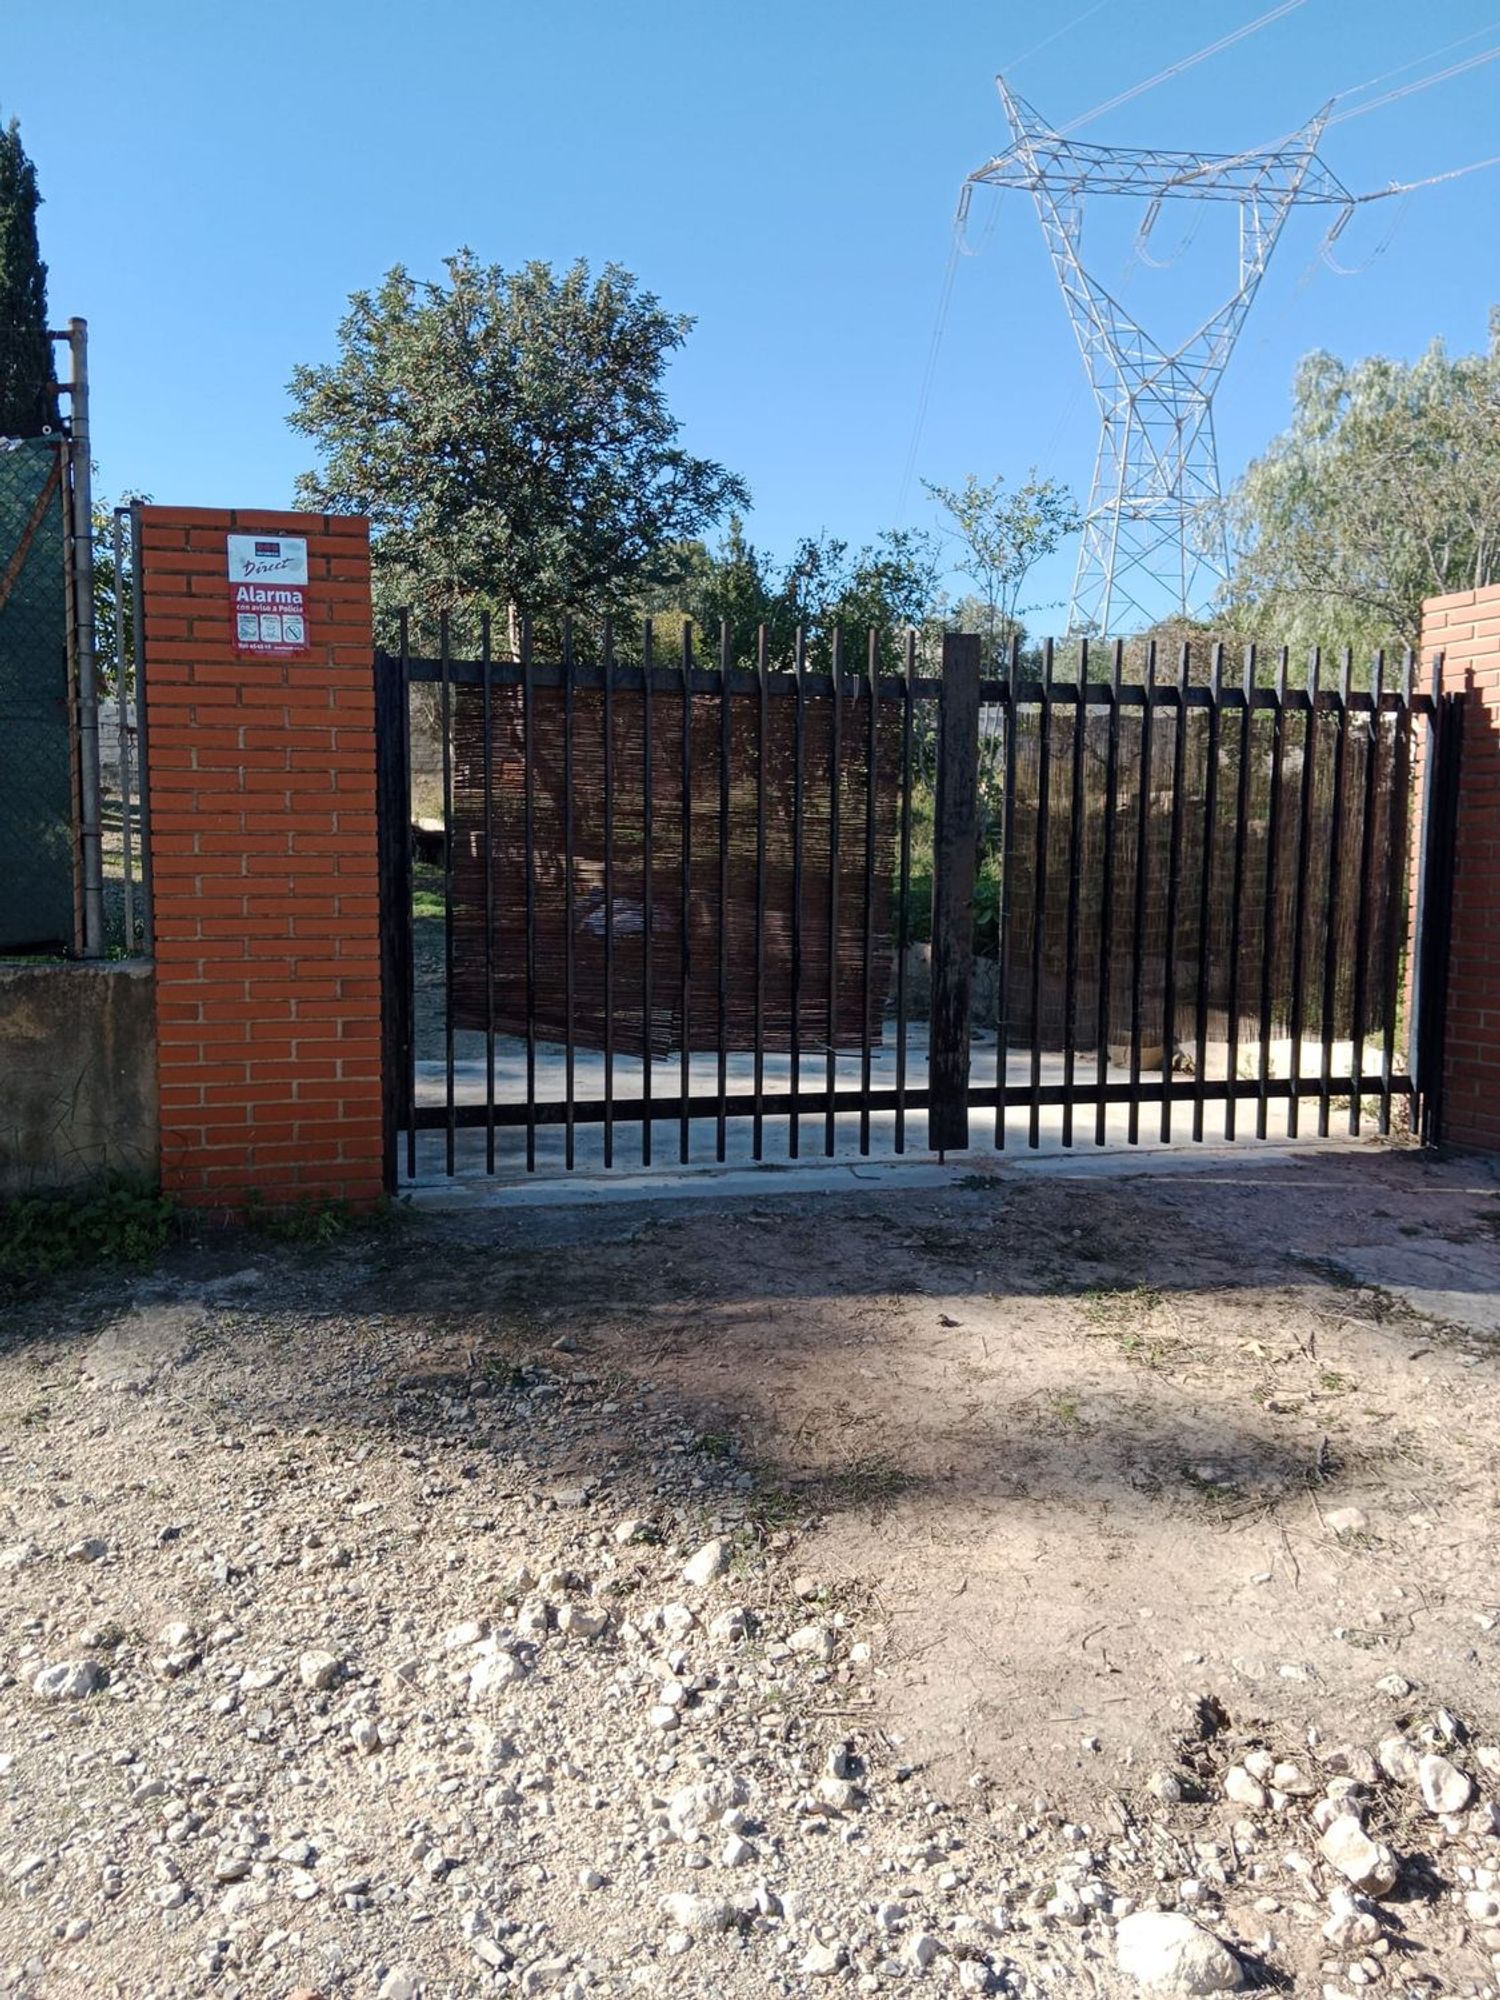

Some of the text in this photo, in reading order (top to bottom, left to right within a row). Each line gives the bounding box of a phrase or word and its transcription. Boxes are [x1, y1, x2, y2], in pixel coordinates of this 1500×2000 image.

[243, 558, 294, 577] Direct
[237, 586, 303, 604] Alarma
[251, 603, 271, 612] aviso
[272, 604, 277, 612] a
